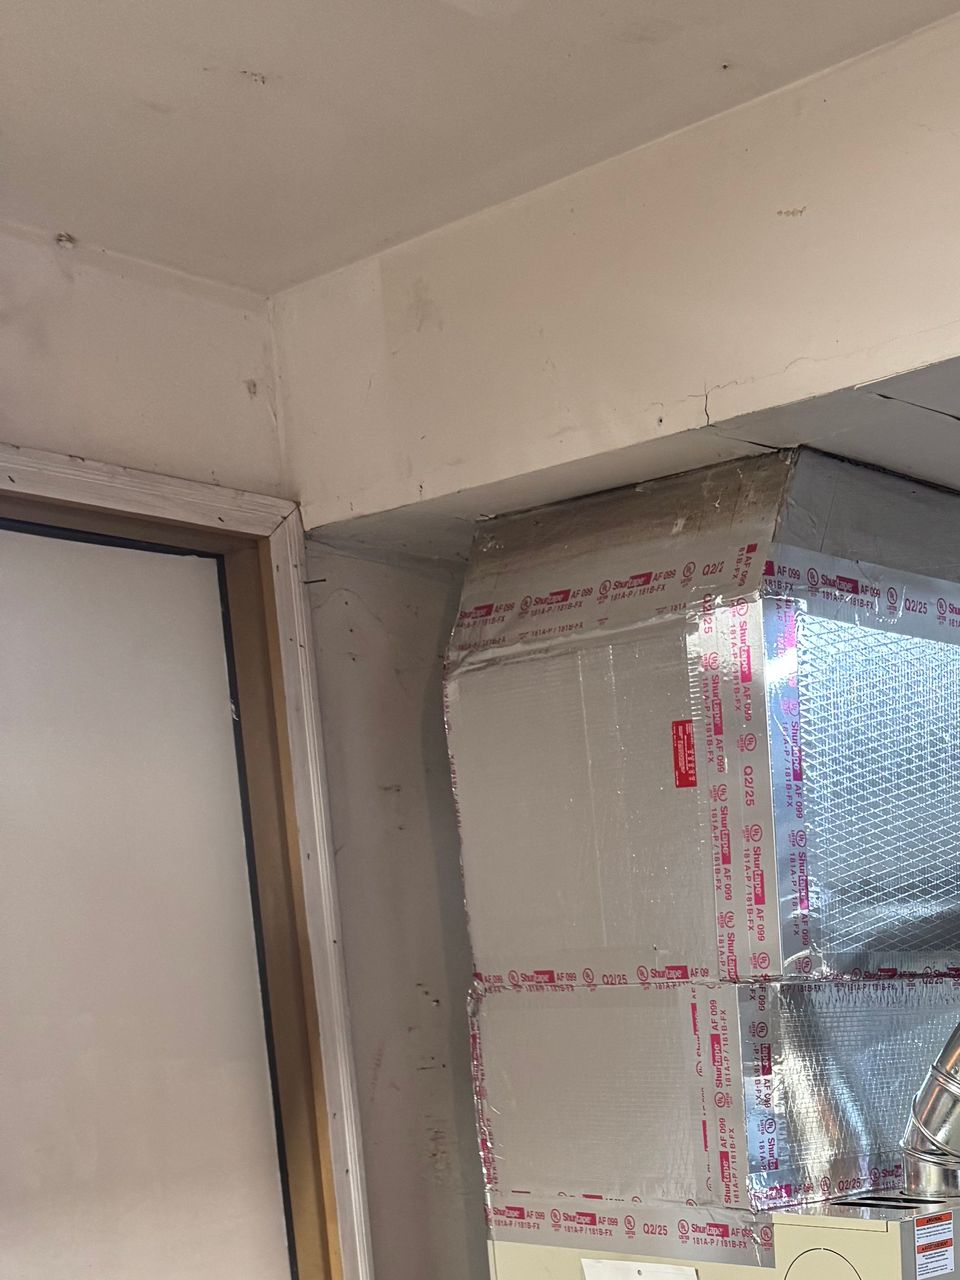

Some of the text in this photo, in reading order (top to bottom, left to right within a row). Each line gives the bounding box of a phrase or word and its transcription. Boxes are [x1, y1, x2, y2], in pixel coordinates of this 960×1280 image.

[777, 566, 800, 580] AF 099
[860, 584, 869, 595] AF
[869, 587, 881, 599] 099
[903, 597, 928, 615] Q2/25
[739, 620, 753, 683] Shurtape
[742, 686, 750, 703] AF
[711, 674, 724, 736] Shurtape
[715, 738, 723, 754] AF
[715, 756, 725, 773] 099
[743, 765, 755, 807] Q2/25
[785, 768, 794, 808] 181B-FX
[794, 784, 802, 800] AF
[795, 801, 804, 819] 099
[719, 805, 731, 865] Shurtape
[711, 808, 722, 891] 181A-P 181B-FX
[723, 867, 732, 884] AF
[752, 845, 766, 906] Shurtape
[798, 851, 810, 910] Shurtape
[724, 885, 733, 902] 099
[743, 848, 755, 932] 181A-P 181B-FX
[756, 907, 765, 925] AF
[801, 913, 809, 929] AF
[757, 926, 766, 942] 099
[802, 930, 811, 946] 099
[718, 933, 726, 967] 181A-P
[690, 968, 699, 978] AF
[709, 999, 719, 1016] 099
[758, 994, 767, 1012] 099
[710, 1018, 719, 1032] AF
[719, 1008, 732, 1087] 181A-P 181B-FX
[710, 1033, 723, 1089] Shurtape
[763, 1078, 771, 1092] AF
[727, 1126, 736, 1161] 181B-FX
[719, 1117, 732, 1204] Shurtape AF 099
[643, 1223, 668, 1236] Q2/25
[691, 1222, 730, 1238] Shurtape
[730, 1227, 741, 1238] AF
[692, 1237, 748, 1249] 181A-P 181B-FX
